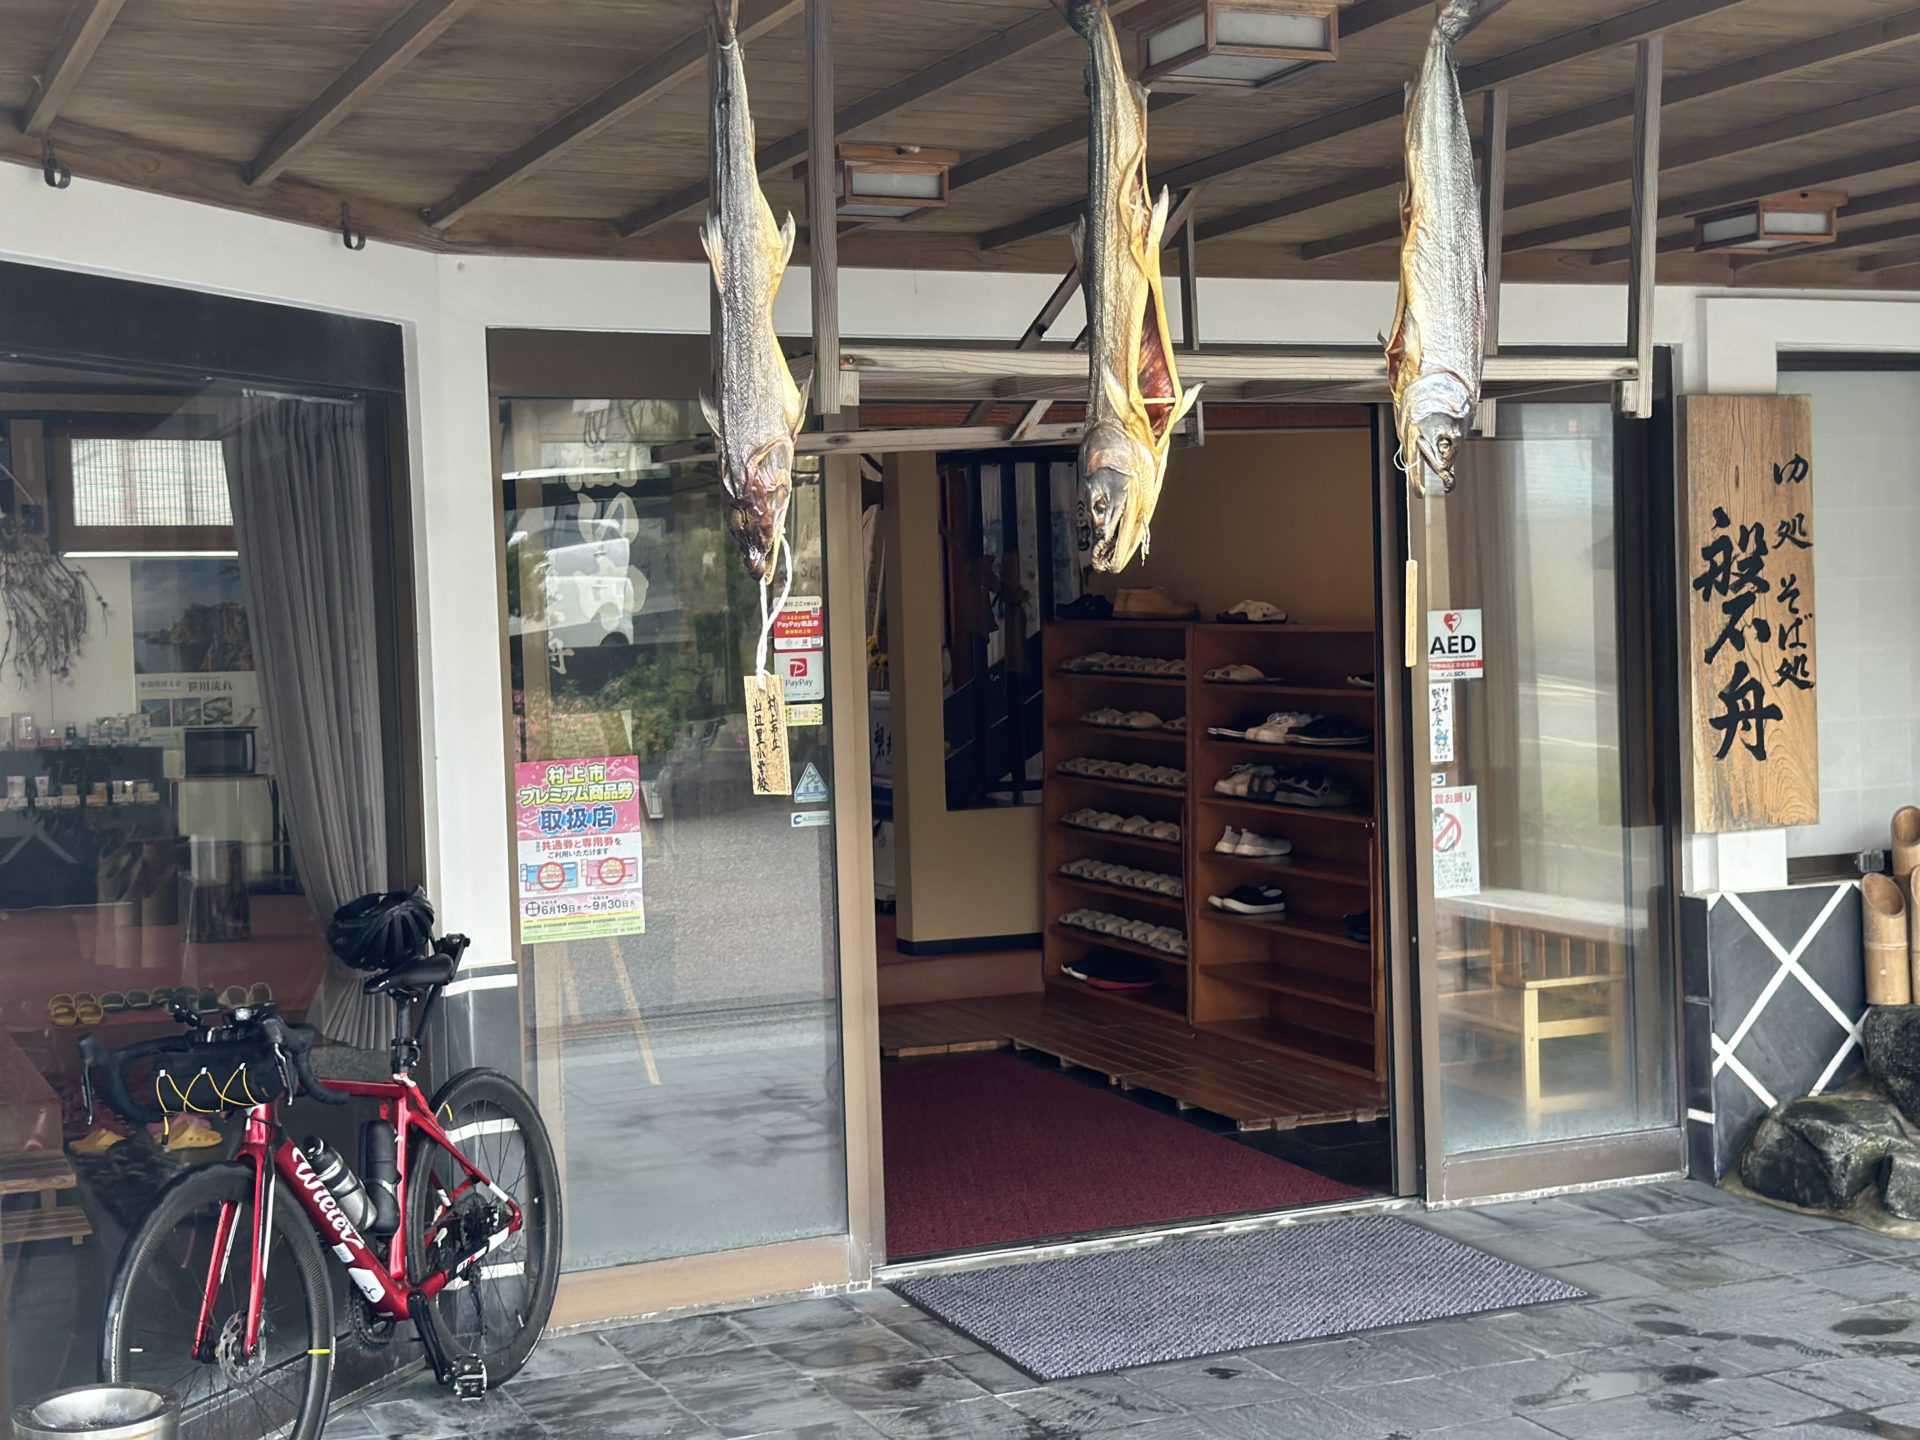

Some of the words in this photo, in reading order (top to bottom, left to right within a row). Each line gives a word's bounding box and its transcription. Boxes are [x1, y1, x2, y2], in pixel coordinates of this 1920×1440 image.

[1774, 573, 1815, 690] そば処
[1430, 635, 1476, 655] AED
[785, 679, 814, 688] PayPay
[547, 763, 606, 785] 村上市
[520, 781, 634, 806] プレミアム商品券
[541, 806, 613, 831] 取扱店
